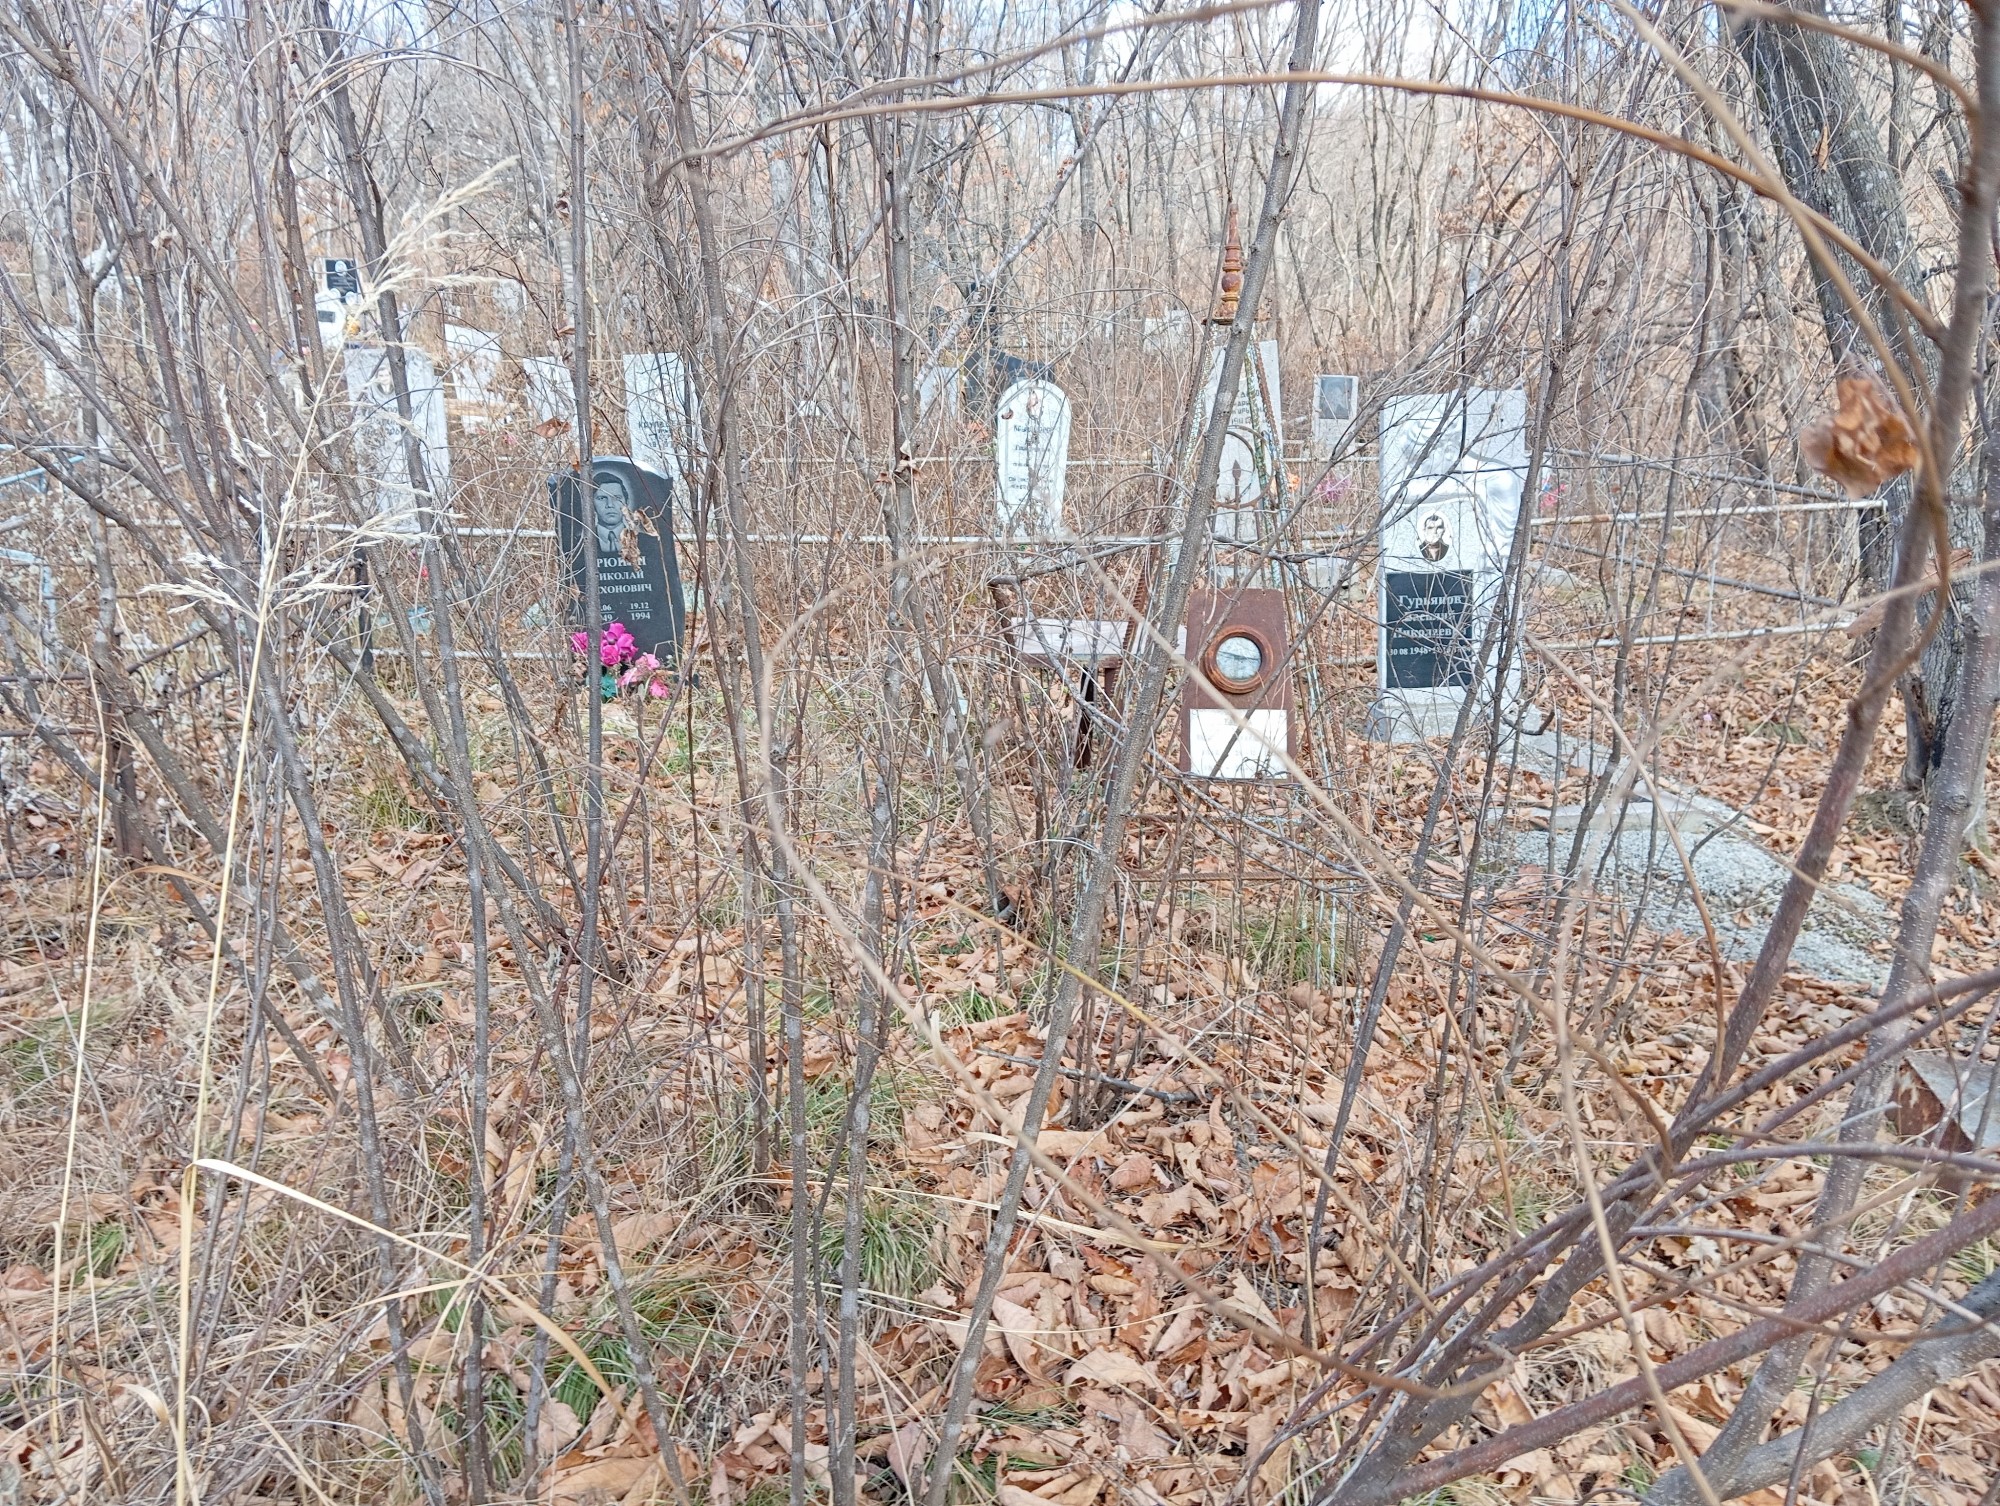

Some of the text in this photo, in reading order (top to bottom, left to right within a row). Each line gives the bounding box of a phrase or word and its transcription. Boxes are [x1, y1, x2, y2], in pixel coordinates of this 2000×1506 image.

[599, 571, 644, 581] ИКОЛАЙ
[598, 584, 652, 594] ХОНОВИЧ
[630, 602, 649, 610] 19.12
[1398, 595, 1462, 609] Гурьянов
[631, 612, 651, 621] 1994
